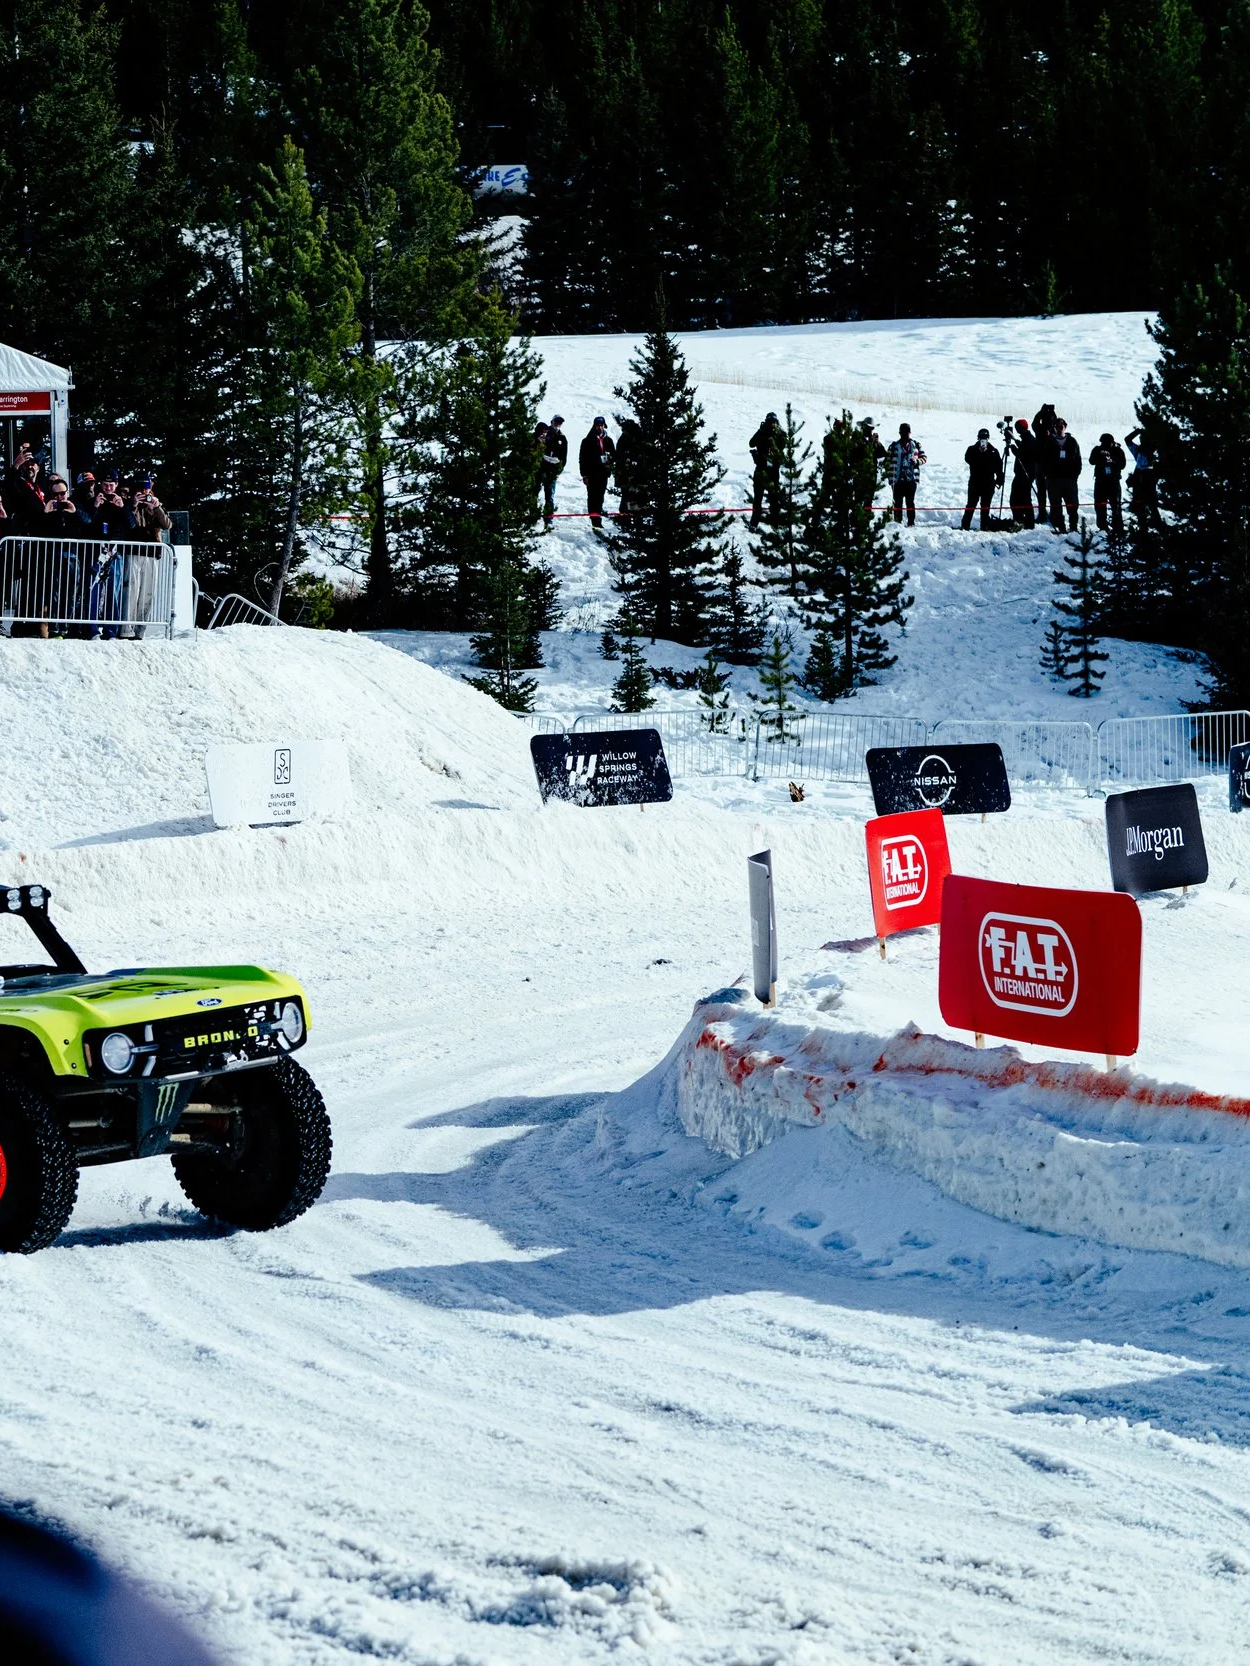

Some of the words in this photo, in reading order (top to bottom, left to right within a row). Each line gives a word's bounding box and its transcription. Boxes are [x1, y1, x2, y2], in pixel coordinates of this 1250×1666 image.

[602, 752, 637, 761] WILLOW
[599, 763, 637, 773] SPRINGS
[597, 775, 638, 785] RACEWAY
[914, 775, 957, 786] NISSAN
[267, 800, 297, 808] DRIVERS
[994, 976, 1065, 1002] INTERNATIONAL
[184, 1025, 258, 1048] BRONO
